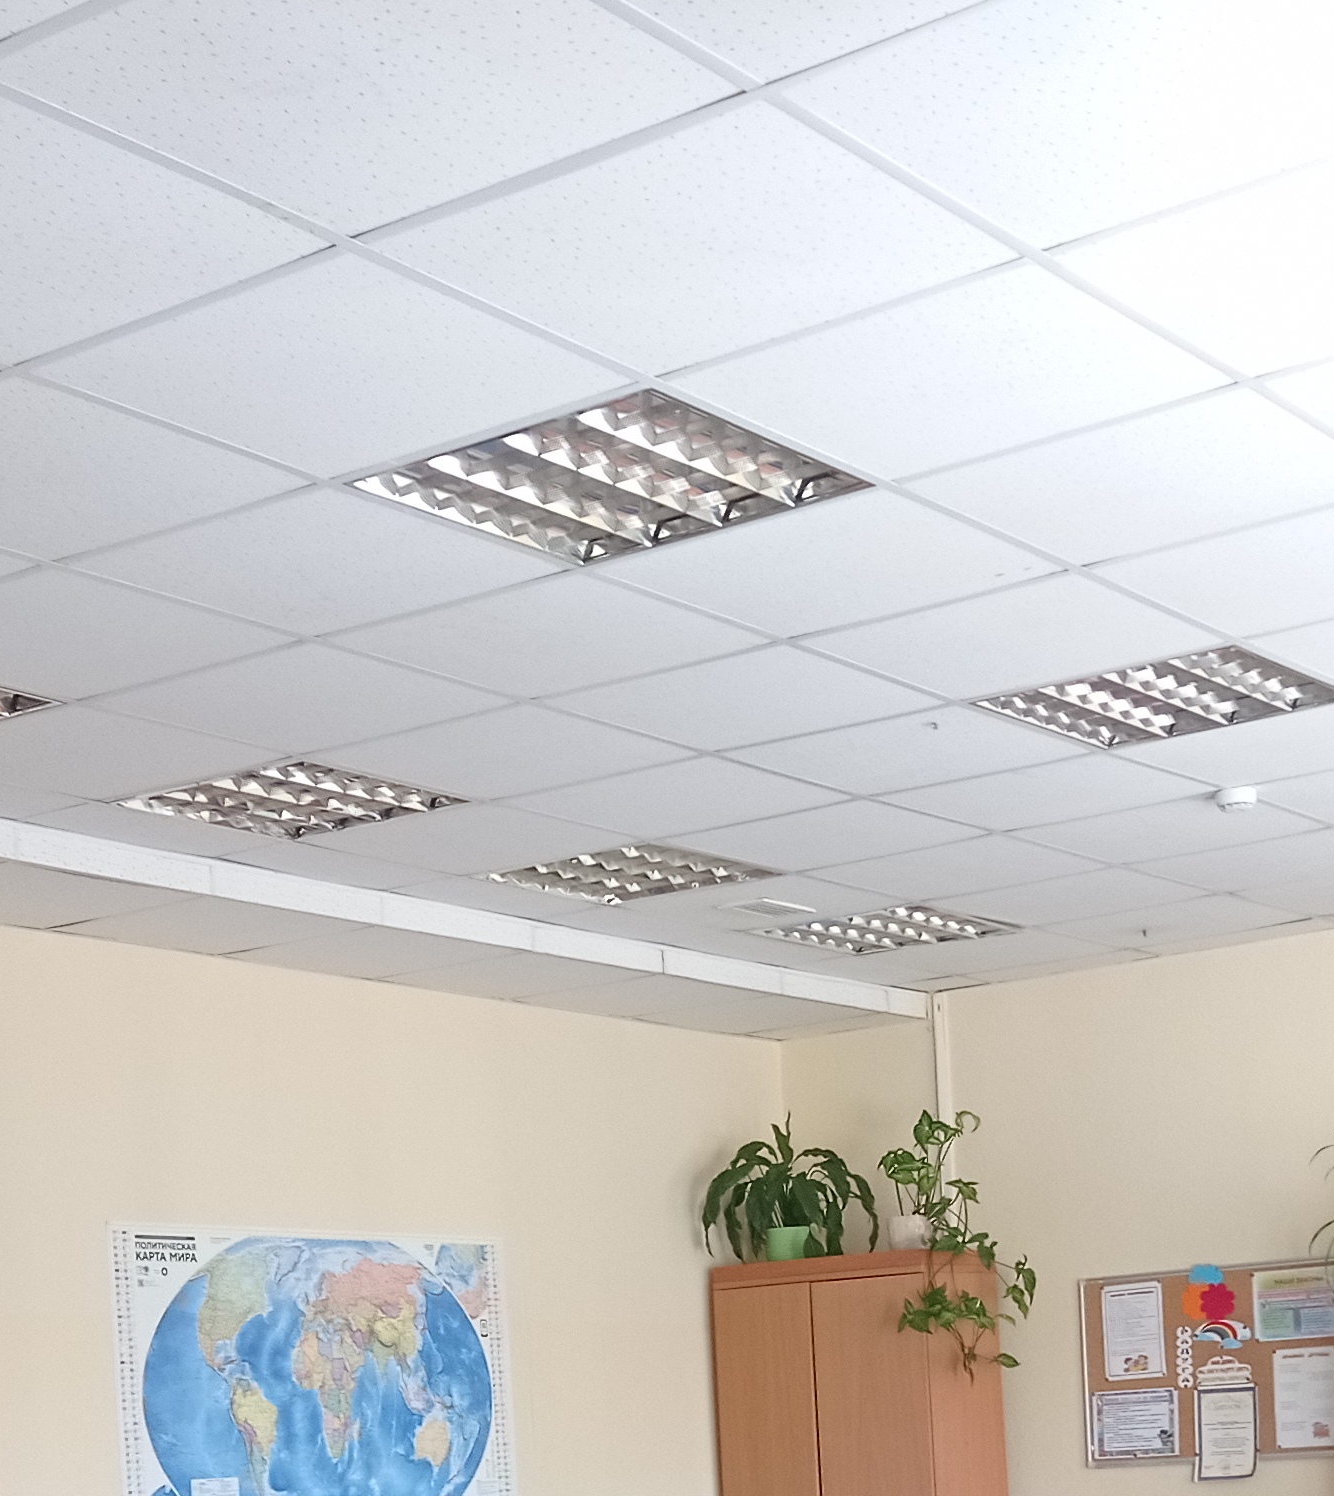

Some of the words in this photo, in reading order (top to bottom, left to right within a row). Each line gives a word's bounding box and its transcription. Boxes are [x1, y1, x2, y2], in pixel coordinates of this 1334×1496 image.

[134, 1241, 196, 1251] ПОЛИТИЧЕСКАЯ
[135, 1251, 167, 1262] КАРТА
[169, 1252, 198, 1263] МИРА
